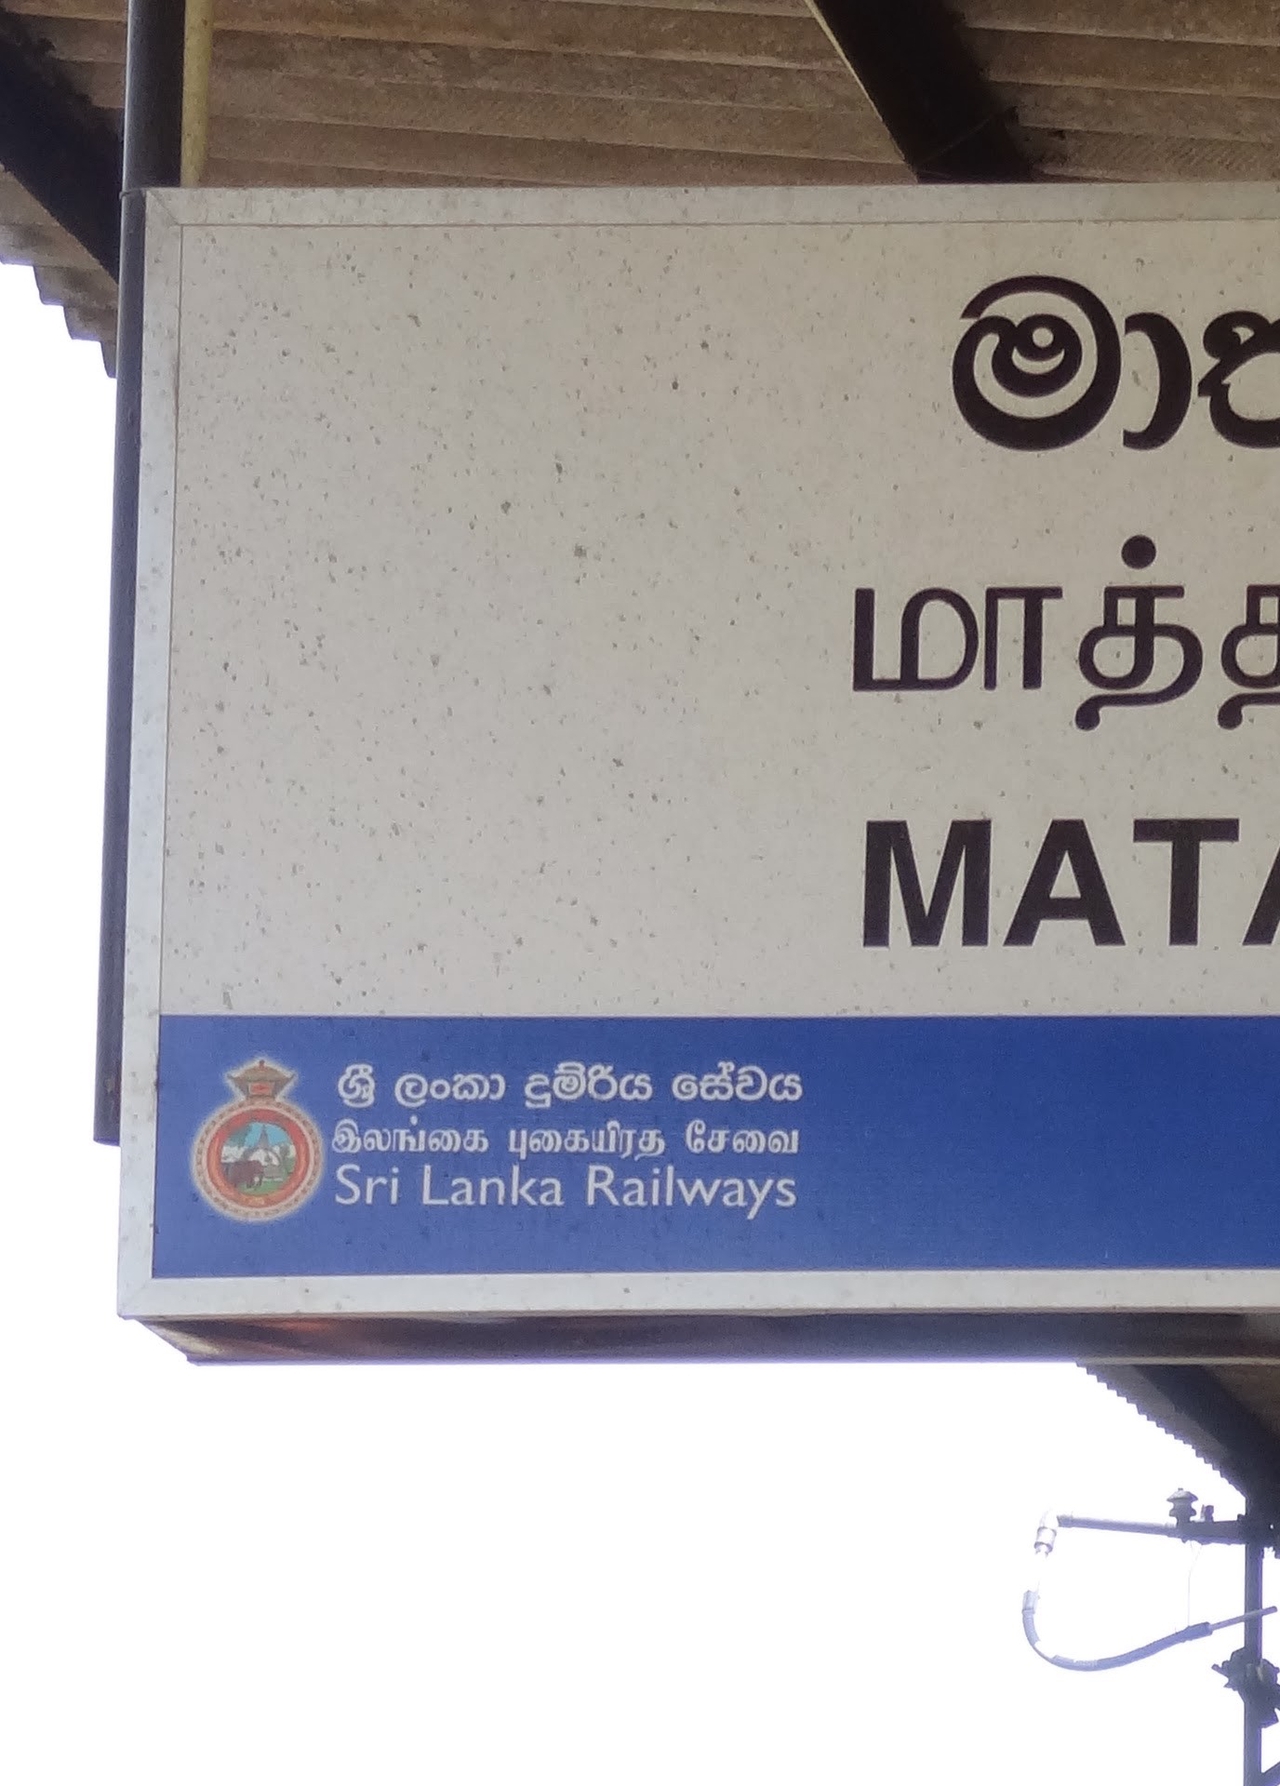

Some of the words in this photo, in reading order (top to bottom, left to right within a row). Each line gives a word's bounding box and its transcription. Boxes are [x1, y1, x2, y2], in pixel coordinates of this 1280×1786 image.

[337, 1064, 376, 1109] ශ්‍රී
[395, 1073, 507, 1109] ලංකා
[525, 1062, 653, 1110] දුම්රිය
[672, 1061, 804, 1103] සේවය
[332, 1116, 490, 1155] இலங்கை
[509, 1120, 666, 1161] புகையிரத
[686, 1119, 800, 1155] சேவை
[335, 1164, 400, 1207] Sri
[422, 1164, 565, 1207] Lanka
[587, 1164, 798, 1220] Railways
